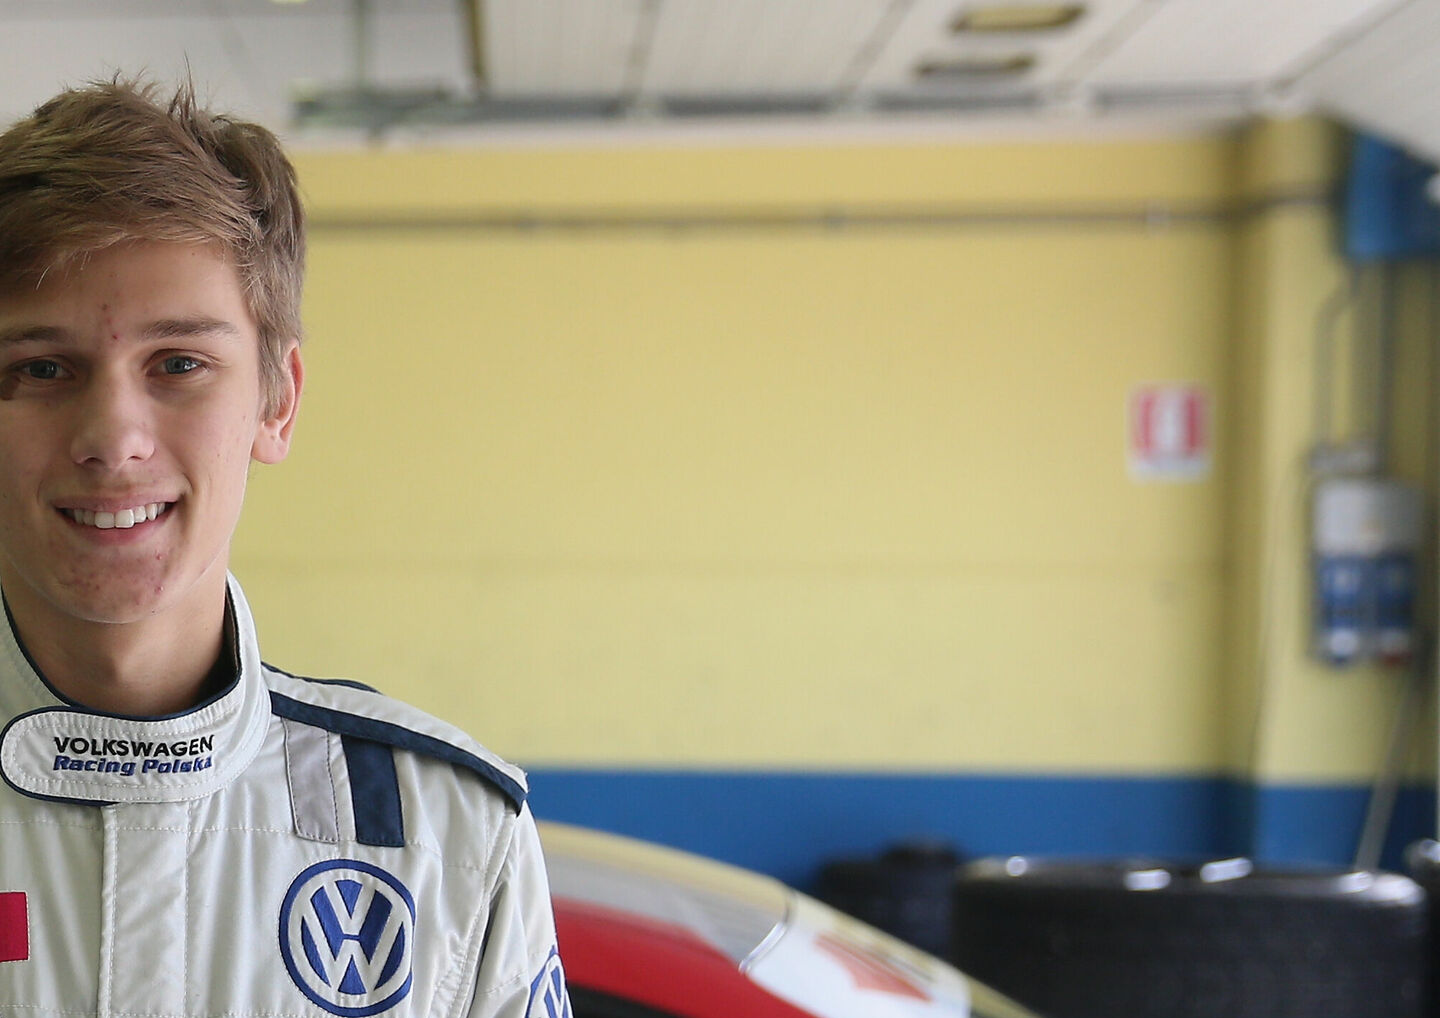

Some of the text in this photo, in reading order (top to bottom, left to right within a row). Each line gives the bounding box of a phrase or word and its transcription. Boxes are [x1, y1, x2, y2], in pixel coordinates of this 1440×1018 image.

[53, 734, 215, 757] VOLKSWAGEN
[53, 755, 214, 777] Racing Polska
